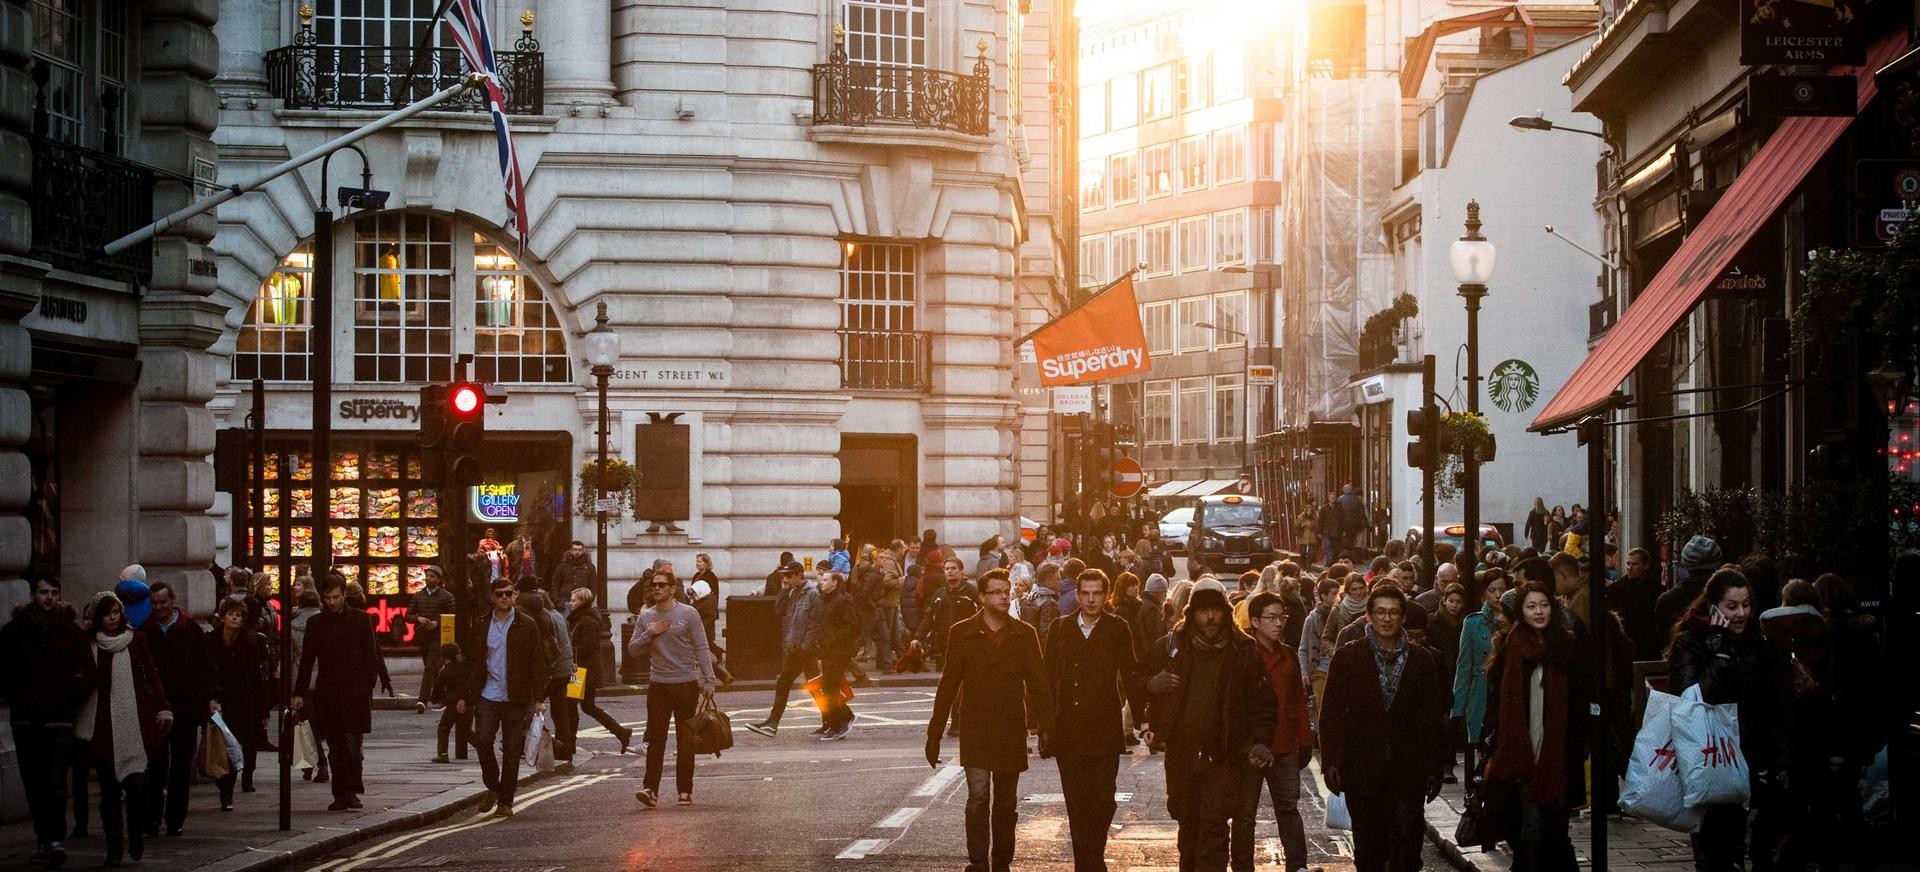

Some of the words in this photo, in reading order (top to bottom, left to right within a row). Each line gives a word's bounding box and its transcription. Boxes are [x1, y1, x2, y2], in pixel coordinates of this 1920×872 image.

[1765, 36, 1843, 46] LEICESTER
[1785, 49, 1826, 60] ARMS
[1717, 274, 1767, 289] ndo's
[1043, 346, 1142, 379] Superdry
[609, 370, 648, 380] GENT
[658, 370, 701, 380] STREET
[340, 400, 421, 423] Superdry
[479, 484, 516, 496] T-SHIRT
[481, 494, 520, 506] GALLERY
[1701, 733, 1739, 770] H&M
